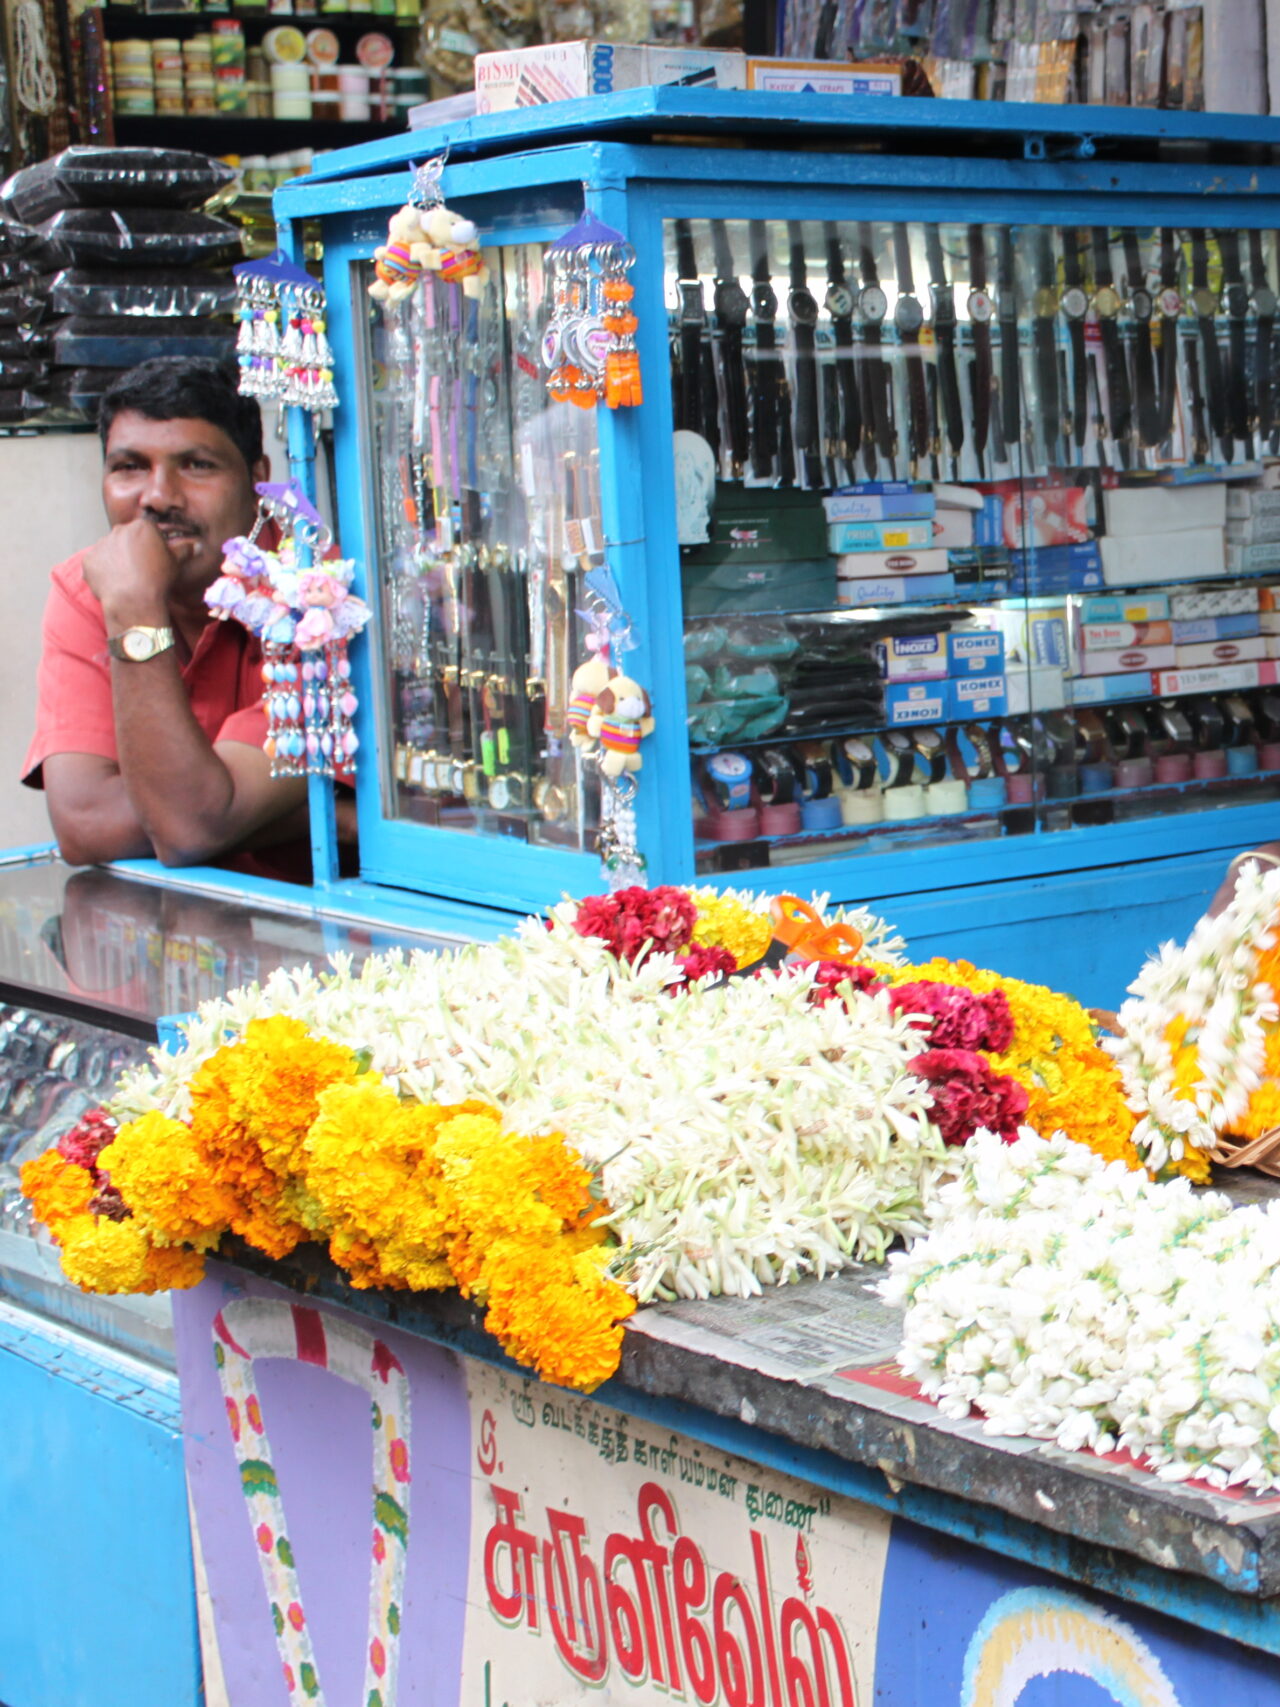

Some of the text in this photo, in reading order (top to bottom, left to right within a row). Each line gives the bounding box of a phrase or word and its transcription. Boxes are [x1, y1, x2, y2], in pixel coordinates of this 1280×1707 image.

[479, 62, 519, 80] BISMI
[956, 638, 997, 650] KONEX
[960, 680, 1002, 692] KONEX
[897, 708, 939, 719] KONEX
